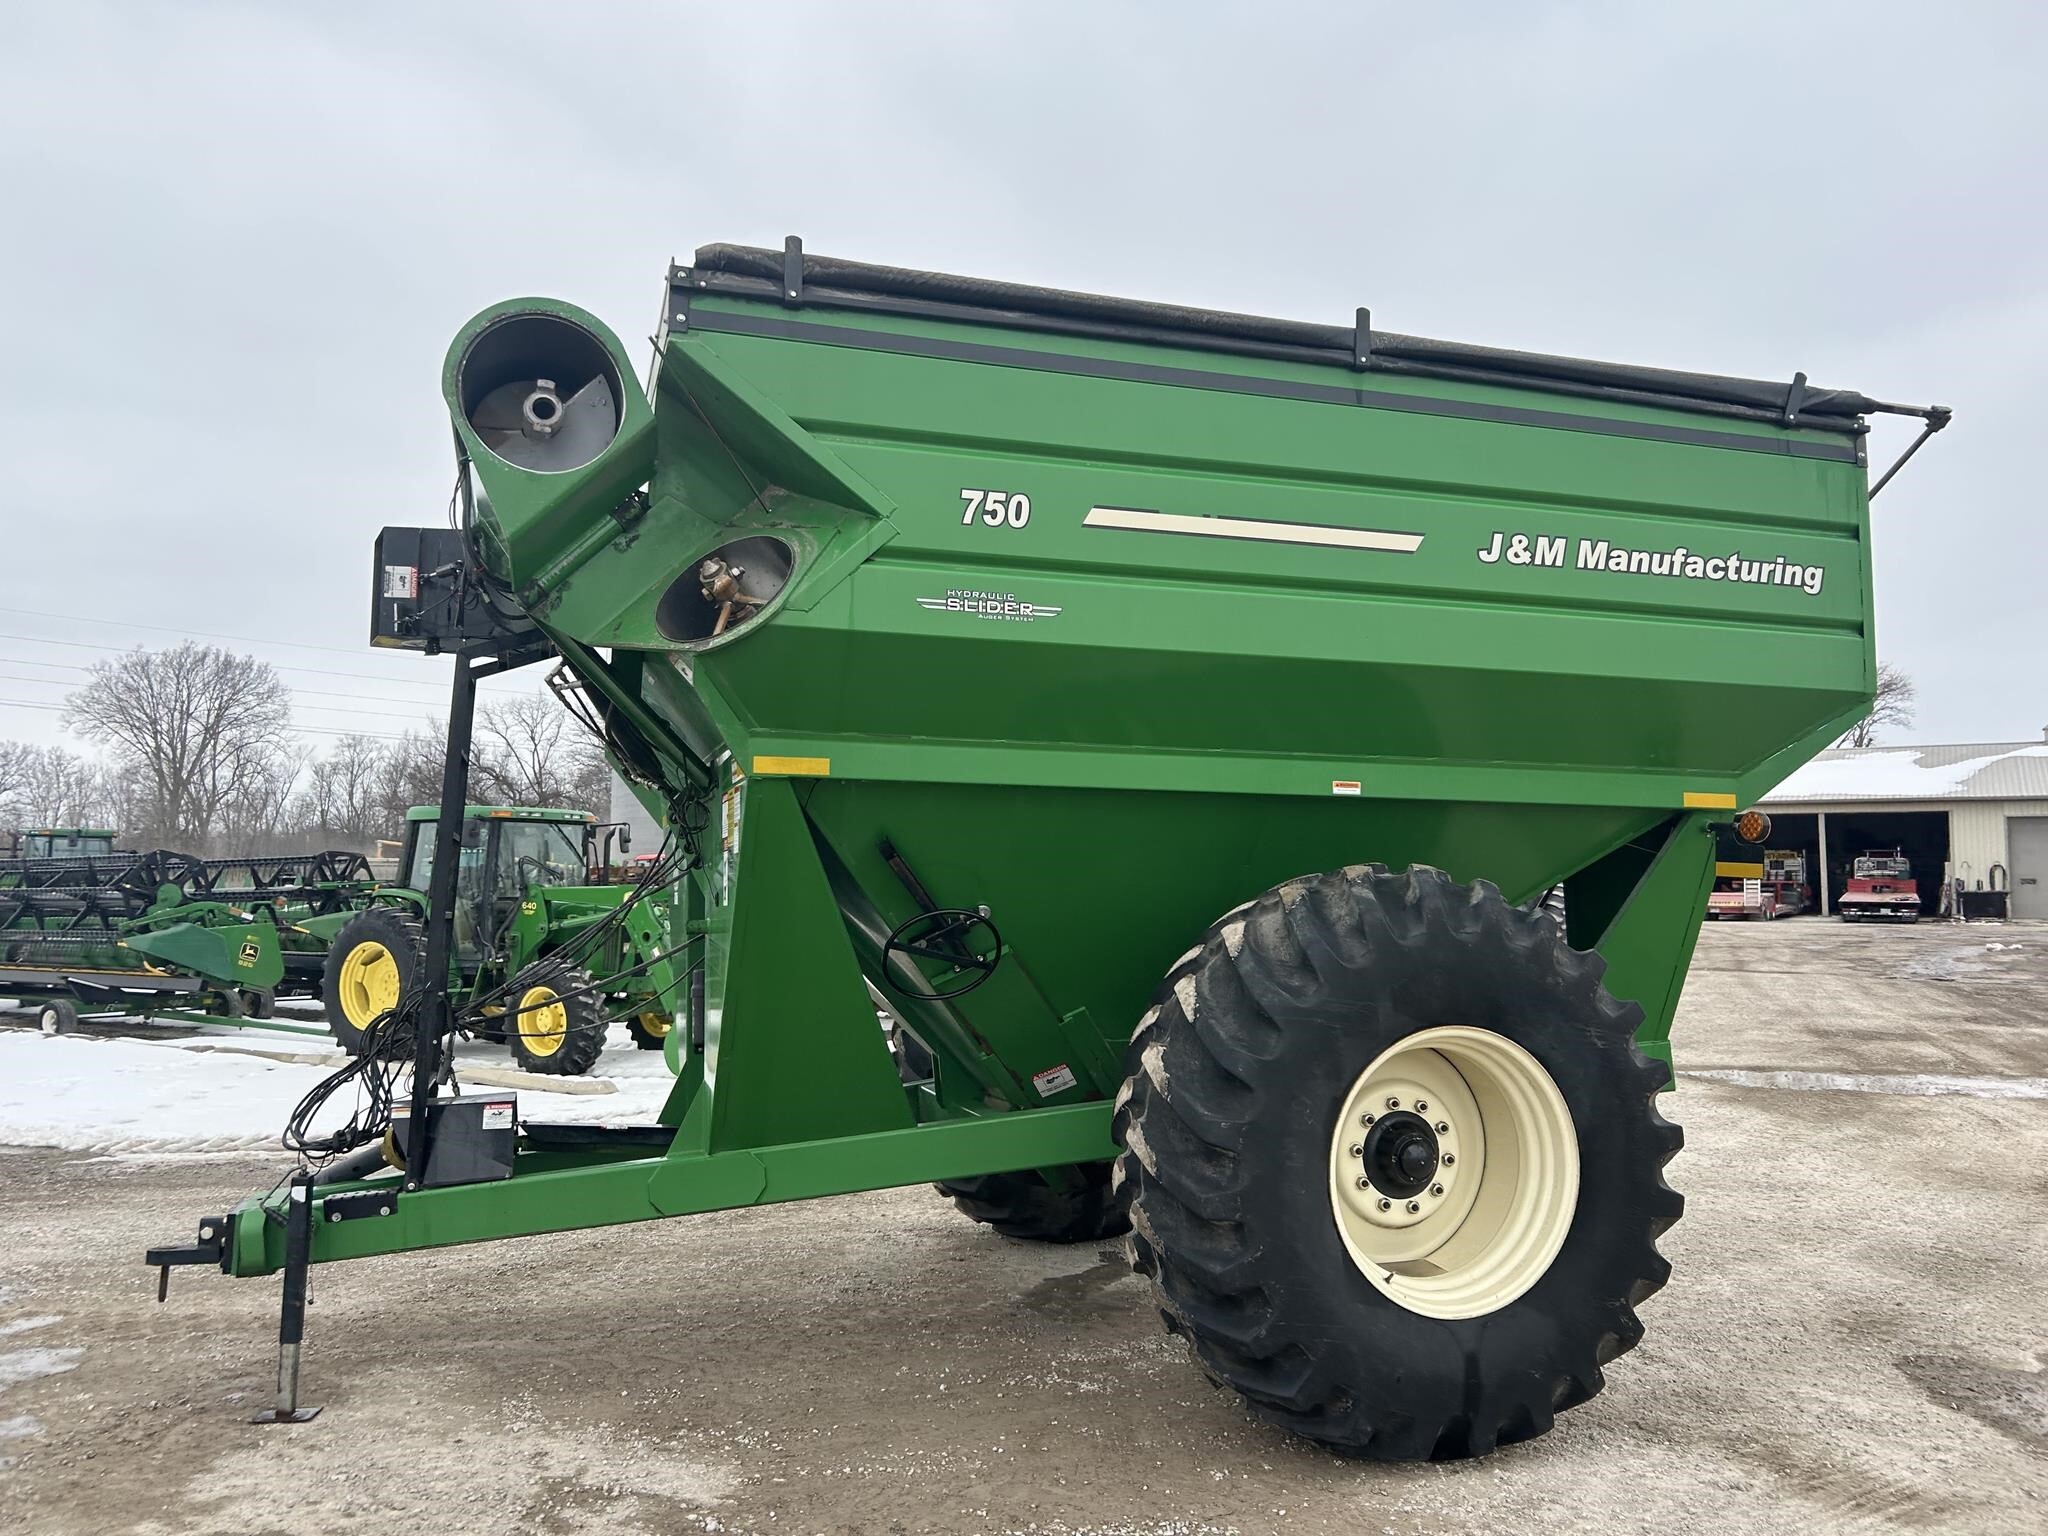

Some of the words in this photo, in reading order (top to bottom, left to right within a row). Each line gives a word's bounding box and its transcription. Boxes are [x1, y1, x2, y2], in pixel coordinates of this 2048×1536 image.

[960, 488, 1031, 529] 750
[1477, 531, 1567, 568] J&M
[1575, 537, 1825, 595] Manufacturing
[946, 589, 1016, 600] HYDRAULIC
[945, 597, 1034, 617] SLIDER
[522, 901, 537, 910] 640
